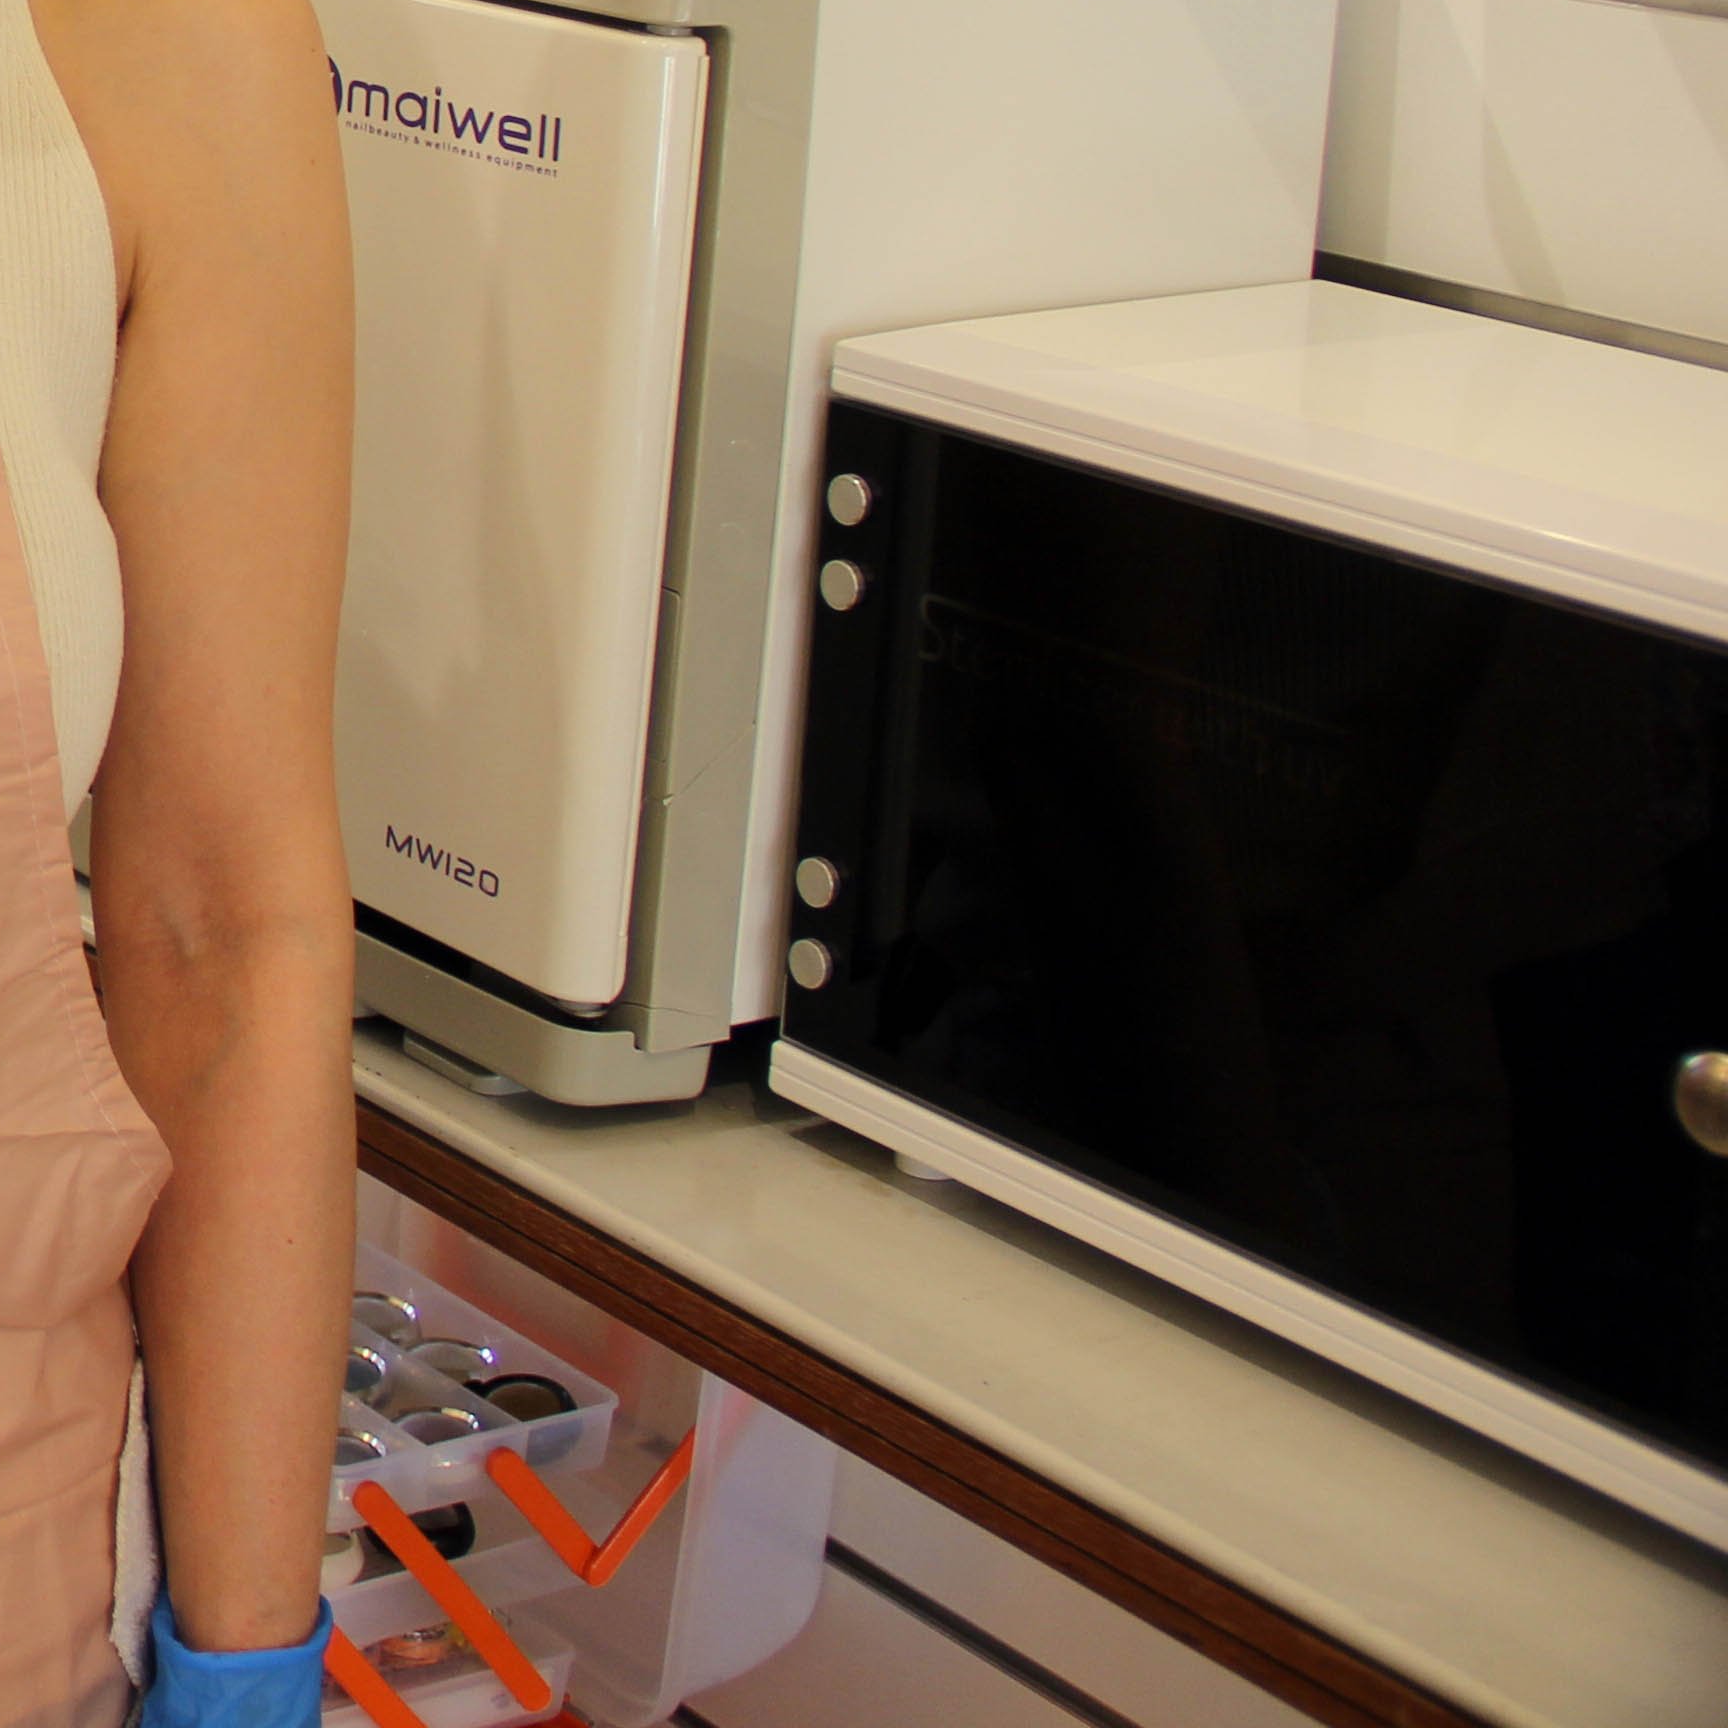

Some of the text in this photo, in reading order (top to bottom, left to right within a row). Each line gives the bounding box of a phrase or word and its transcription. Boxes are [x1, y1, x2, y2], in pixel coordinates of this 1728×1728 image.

[345, 119, 409, 143] nailbeauty
[425, 139, 481, 160] wellness
[486, 154, 559, 178] equipment
[347, 79, 561, 162] maiwell
